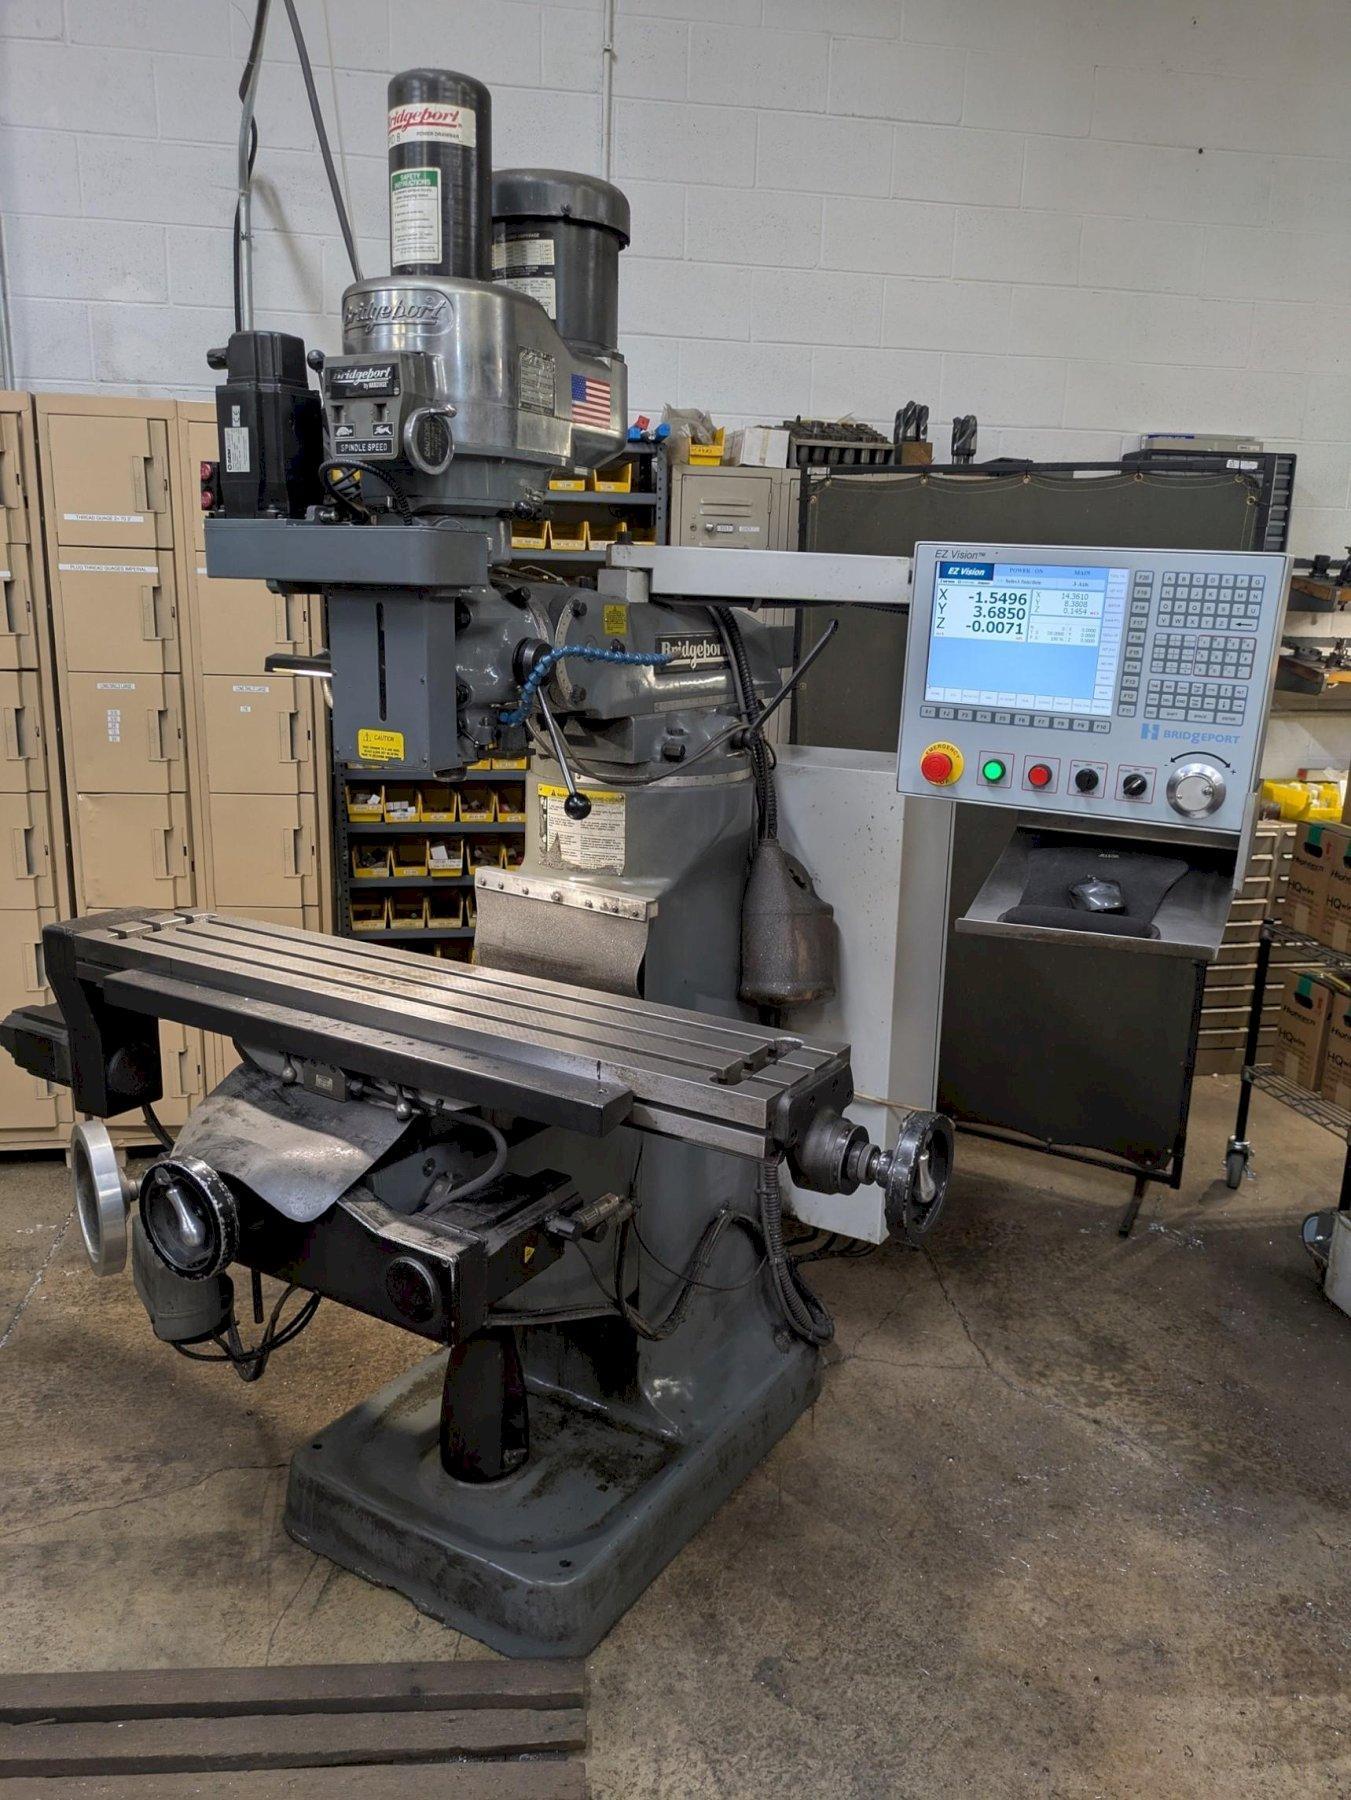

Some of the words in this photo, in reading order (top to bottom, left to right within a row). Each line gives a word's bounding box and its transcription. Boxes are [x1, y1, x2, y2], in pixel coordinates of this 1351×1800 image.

[340, 444, 366, 452] SPINDLE
[368, 443, 388, 451] SPEED
[935, 550, 948, 558] EZ
[960, 568, 986, 576] Vision
[938, 589, 948, 600] X
[968, 592, 1027, 605] -1.5496
[938, 603, 947, 614] Y
[974, 606, 1026, 620] 3.6850
[936, 618, 945, 629] Z
[966, 620, 1023, 634] -0.0071
[661, 640, 720, 669] Bridgepor
